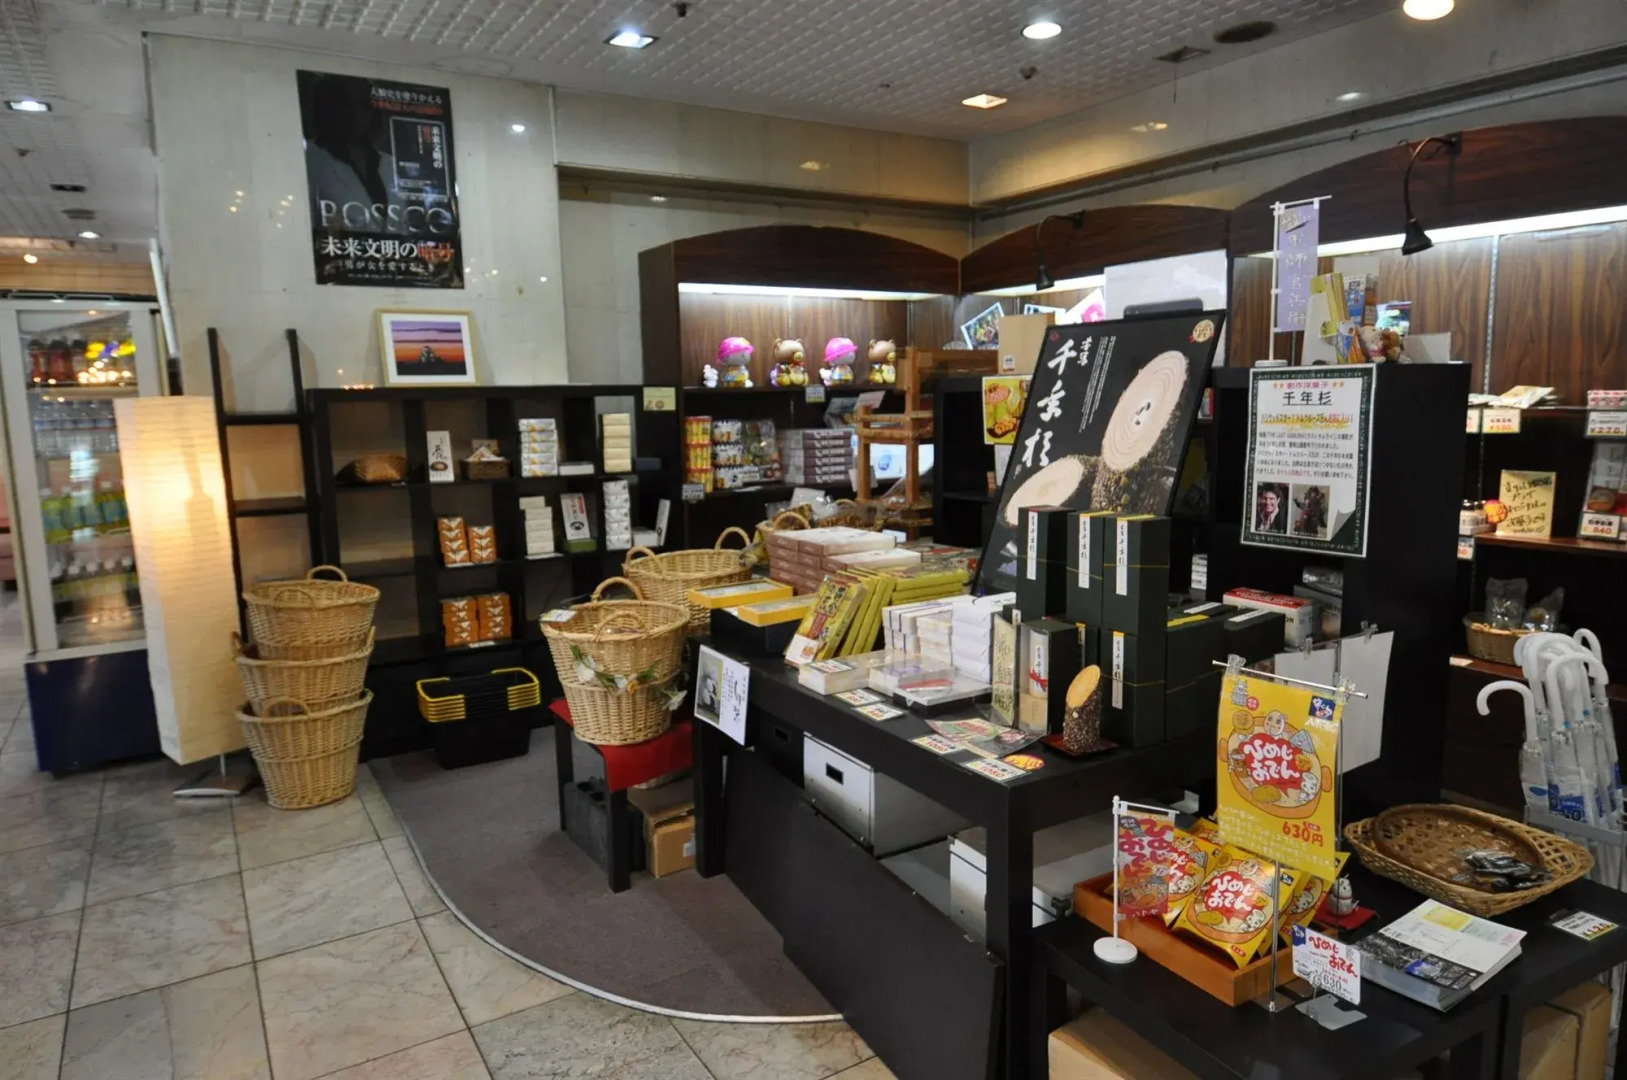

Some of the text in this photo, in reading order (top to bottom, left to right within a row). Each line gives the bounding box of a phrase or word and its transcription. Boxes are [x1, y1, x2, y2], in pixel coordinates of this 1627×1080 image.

[1283, 391, 1333, 404] 千年杉
[1243, 739, 1293, 760] ひめじ
[1251, 759, 1300, 781] おでん
[1282, 821, 1323, 847] 630円
[1212, 875, 1255, 896] ひめじ
[1207, 889, 1253, 911] おでん
[1329, 954, 1358, 978] おでん
